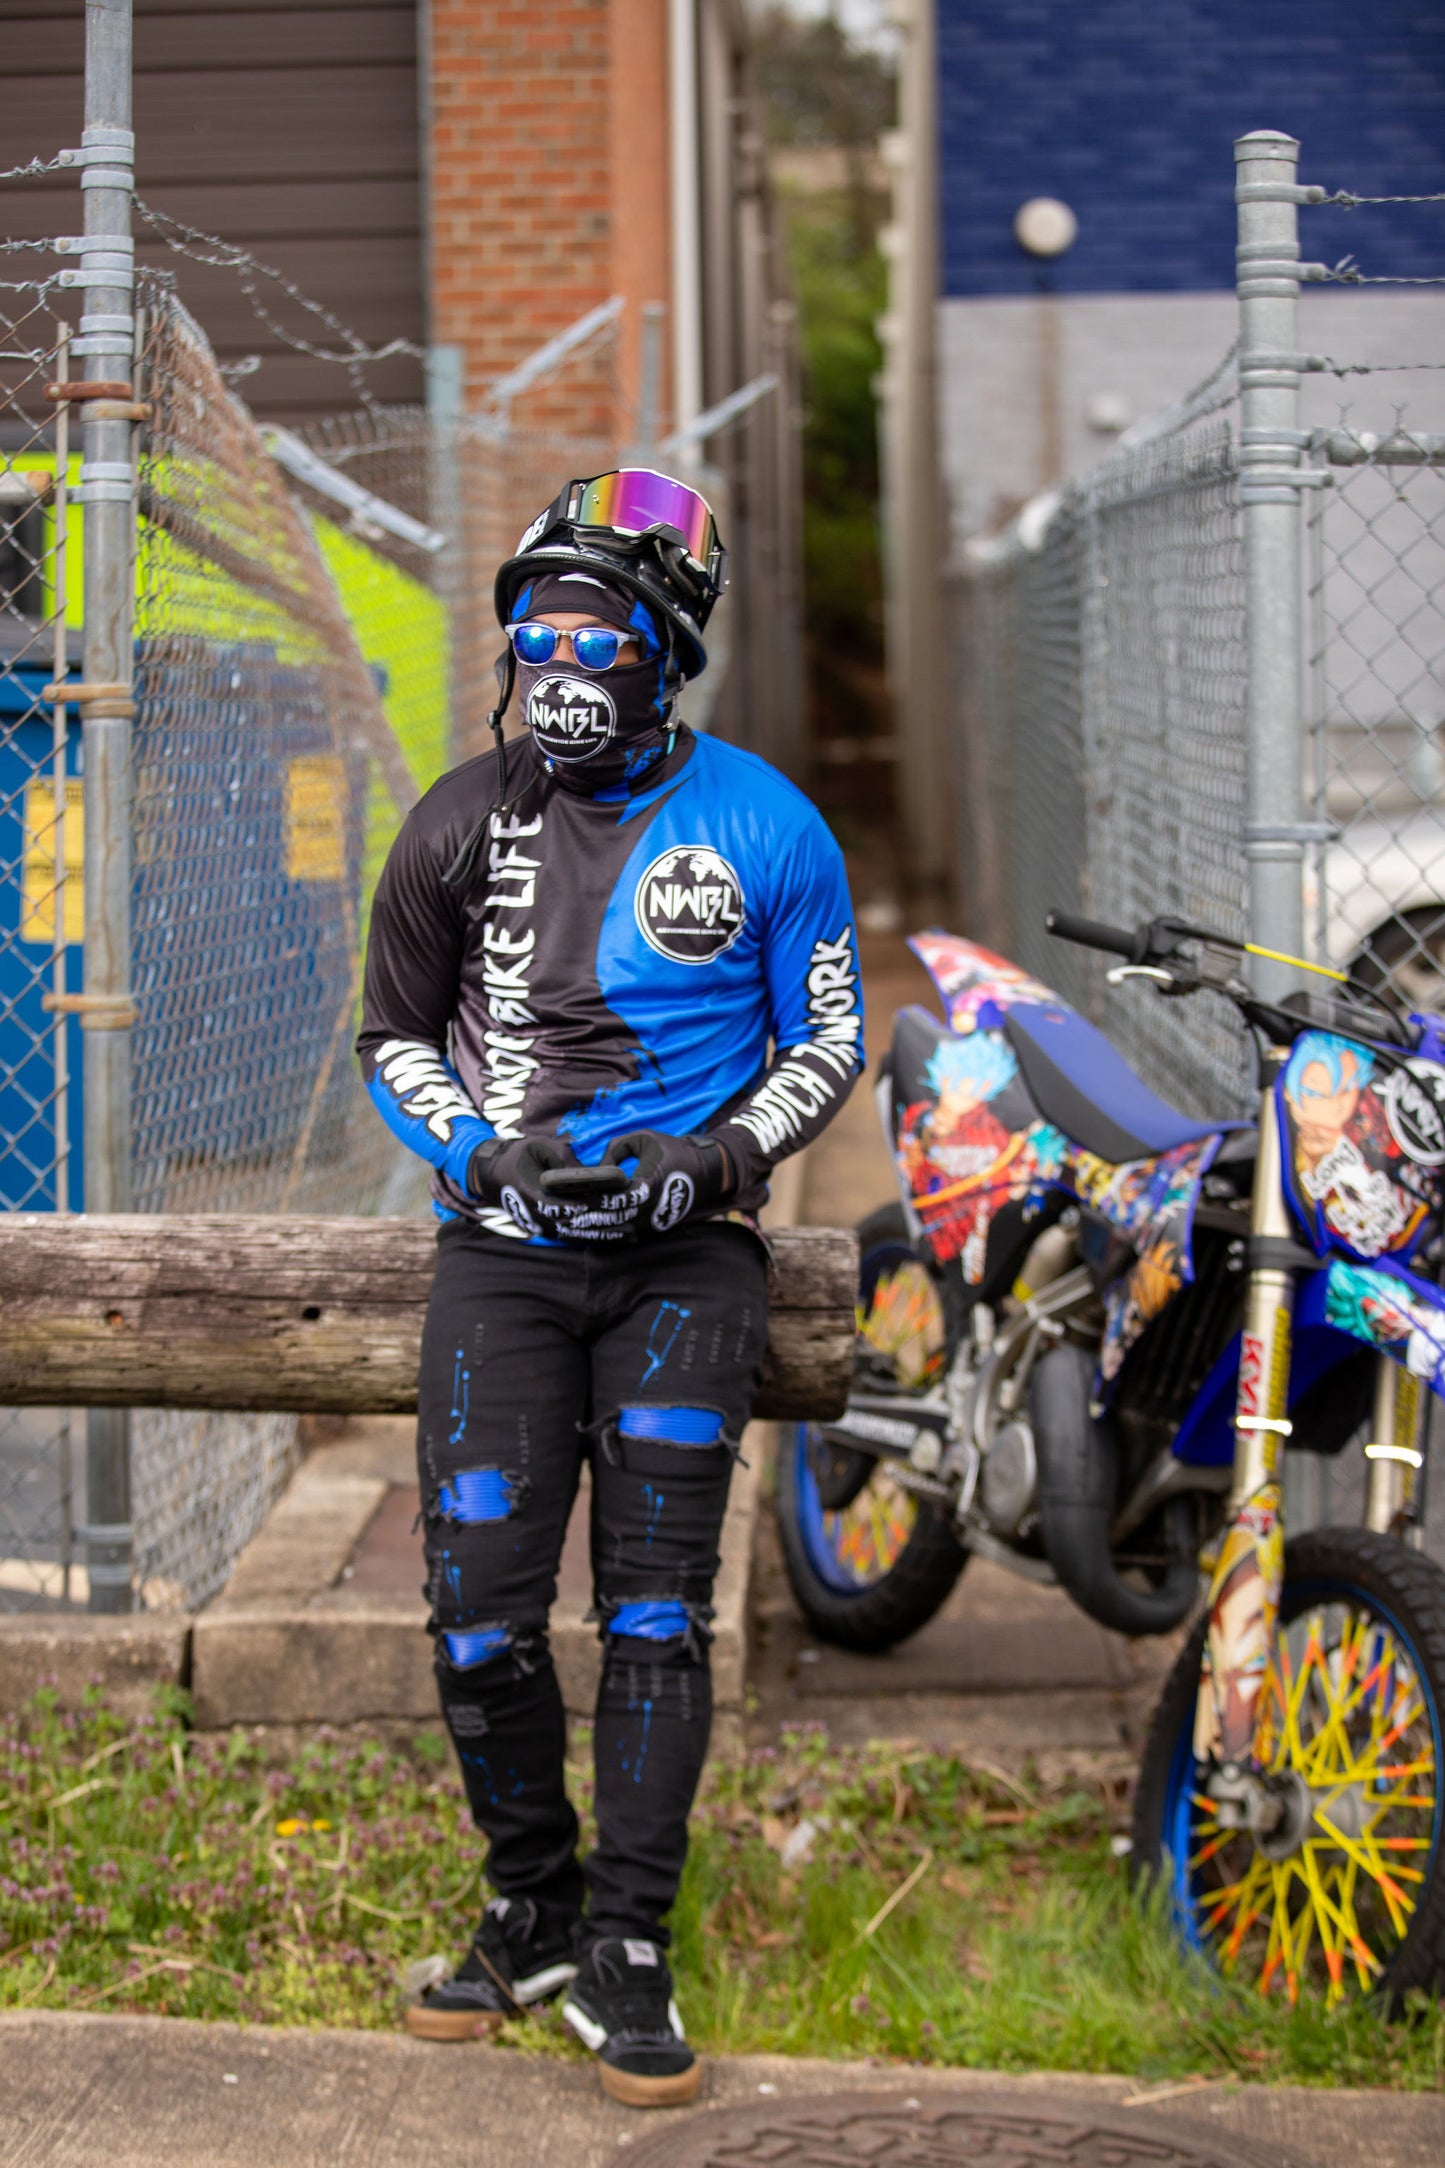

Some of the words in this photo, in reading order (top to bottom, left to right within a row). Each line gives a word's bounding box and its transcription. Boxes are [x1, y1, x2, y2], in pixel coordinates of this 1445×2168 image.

[531, 699, 608, 739] NWBL
[484, 812, 543, 908] LIFE
[649, 880, 741, 928] NWBL
[482, 922, 540, 1026] BIKE
[729, 1061, 836, 1154] WATCH
[600, 1194, 628, 1211] LIFE
